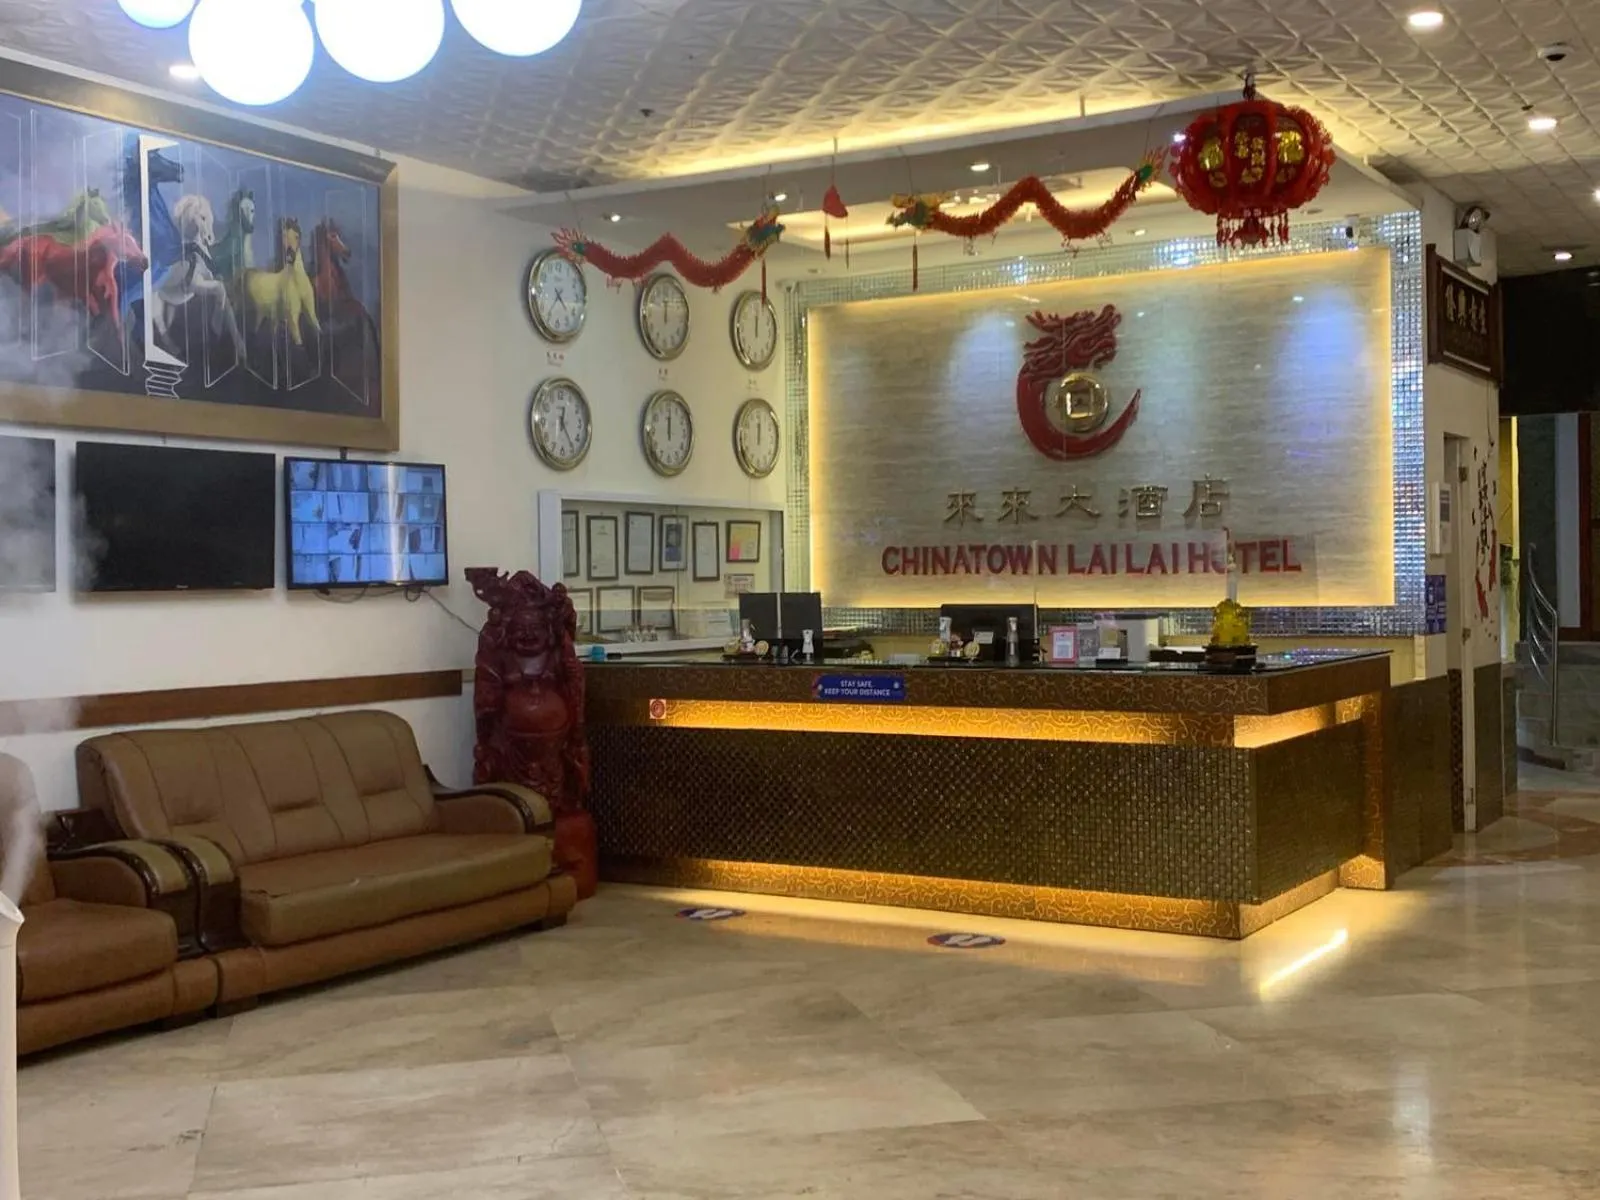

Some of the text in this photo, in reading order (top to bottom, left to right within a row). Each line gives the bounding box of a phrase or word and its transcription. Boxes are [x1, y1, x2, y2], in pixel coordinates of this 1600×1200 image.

[881, 543, 1058, 576] CHINATOWN
[1067, 543, 1117, 575] LAI
[1125, 542, 1179, 575] LAI
[840, 680, 855, 688] STAY
[841, 688, 858, 696] YOUR
[859, 688, 890, 696] DISTANCE
